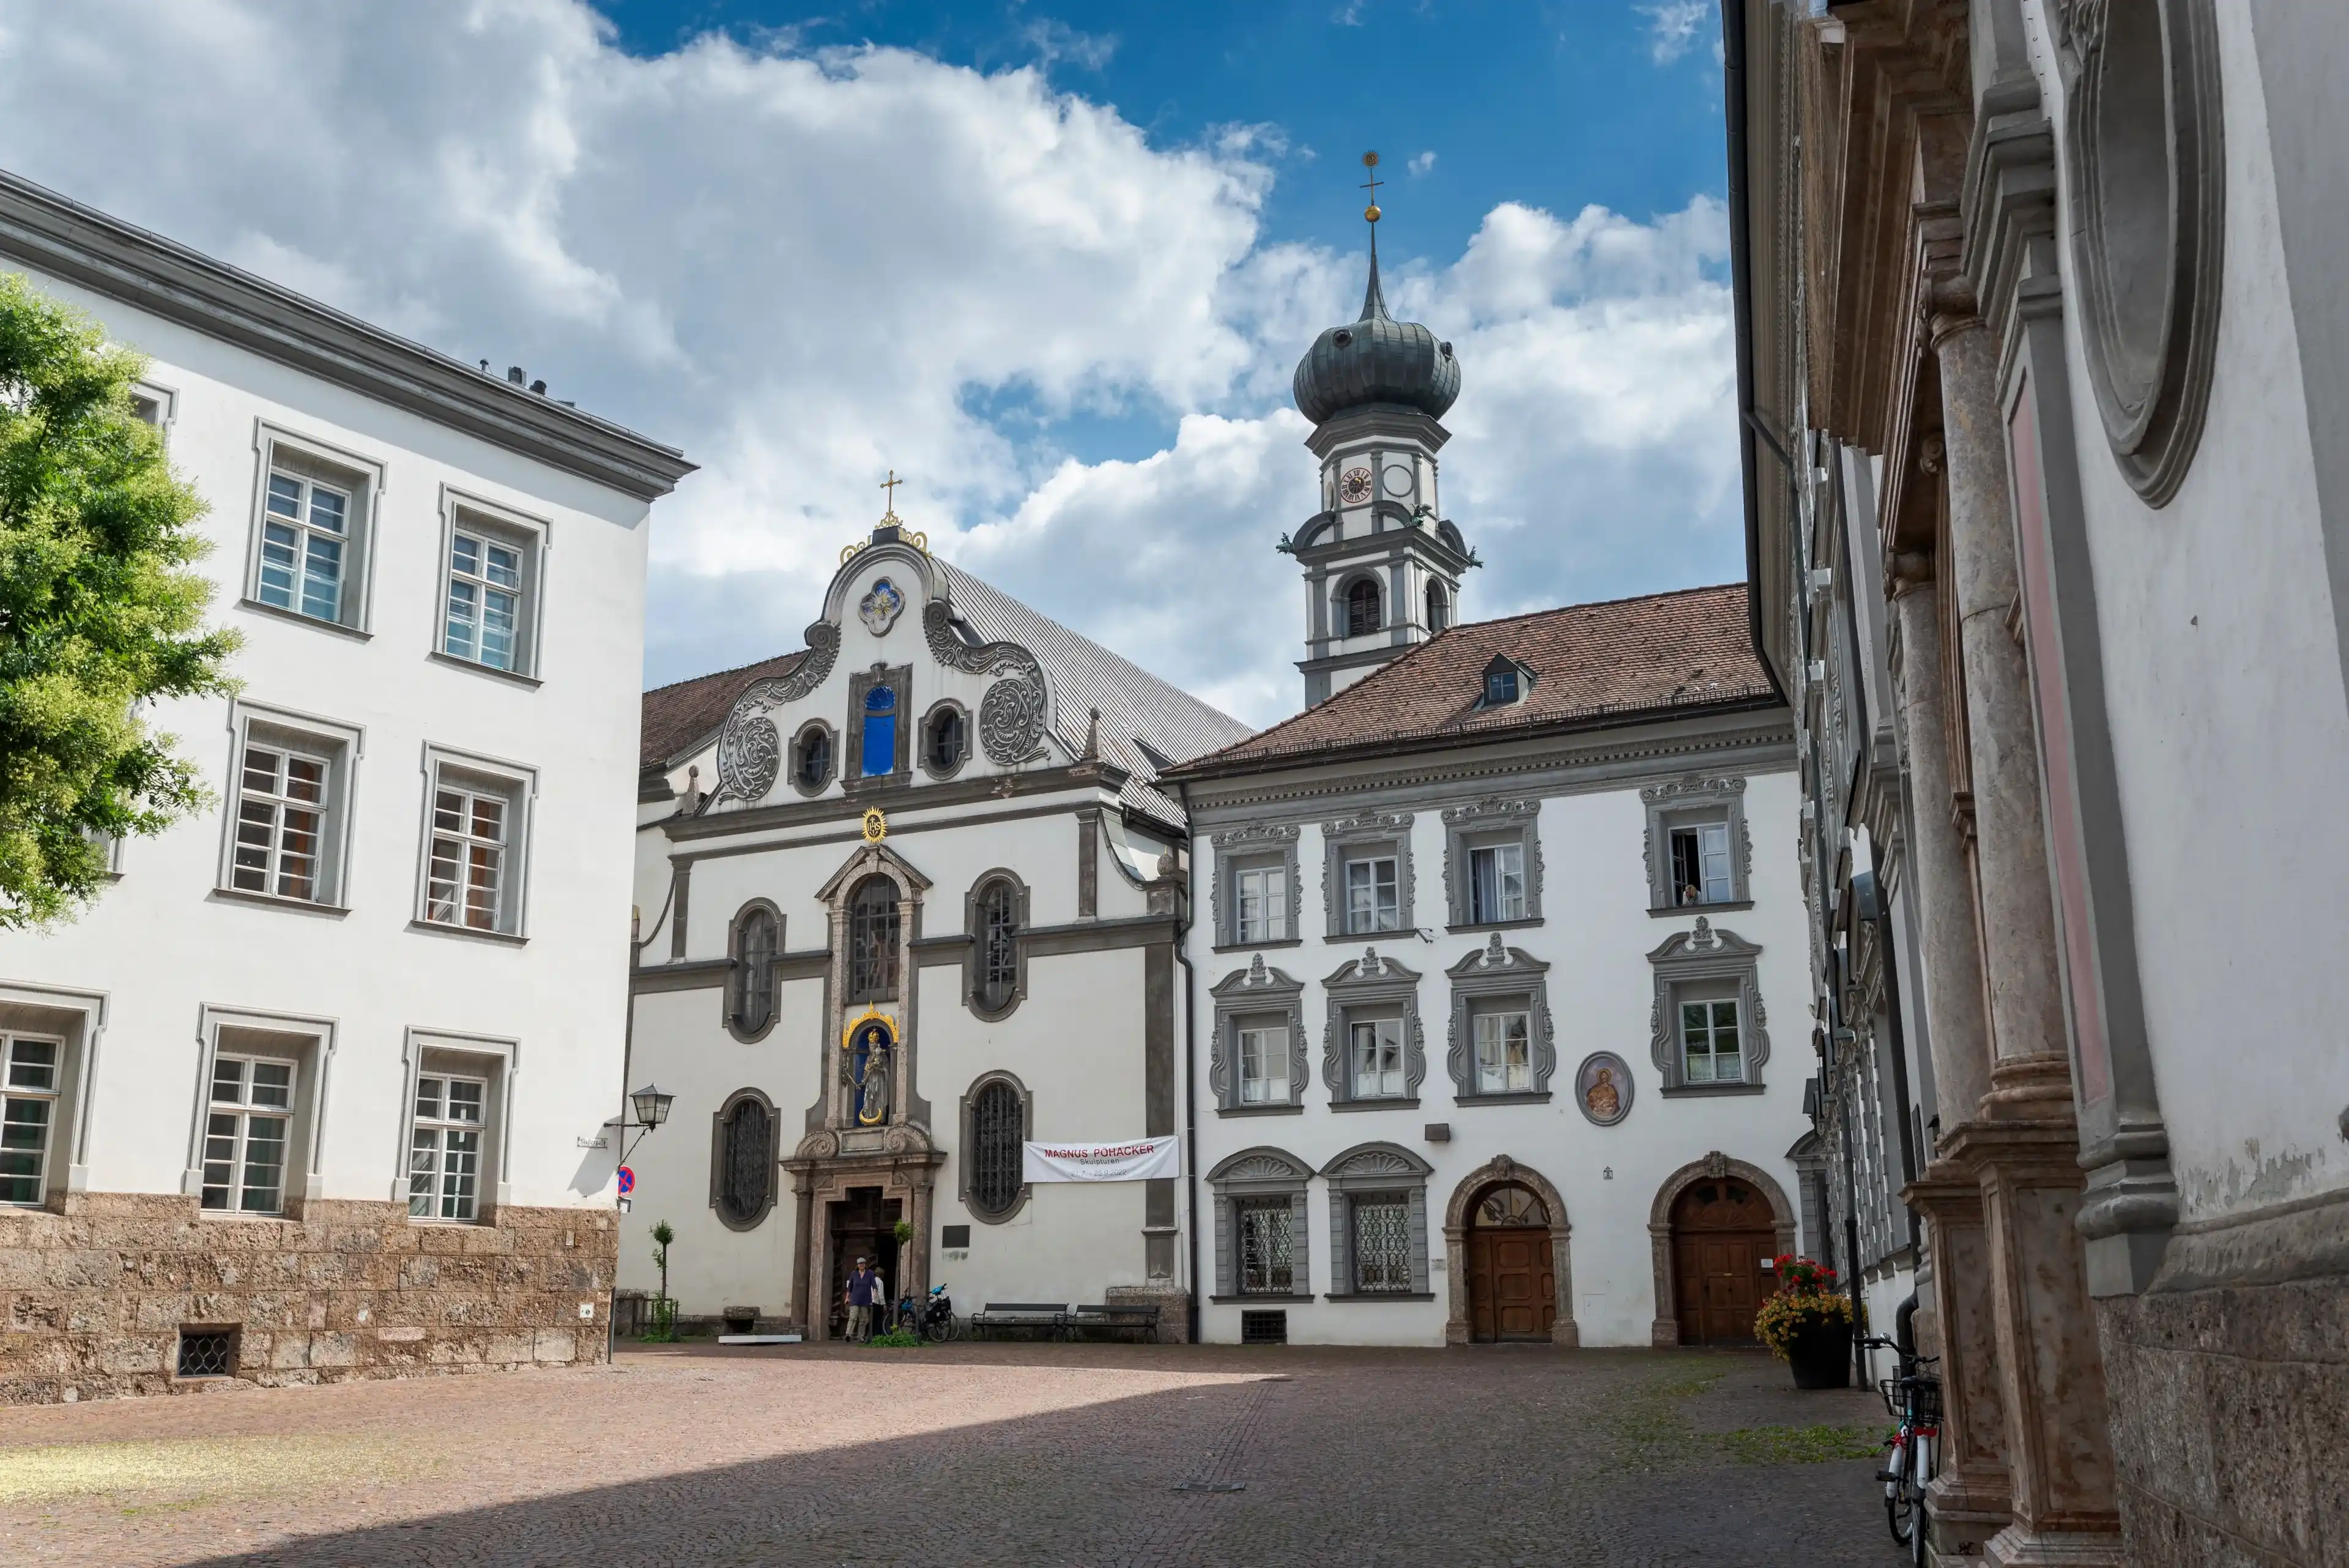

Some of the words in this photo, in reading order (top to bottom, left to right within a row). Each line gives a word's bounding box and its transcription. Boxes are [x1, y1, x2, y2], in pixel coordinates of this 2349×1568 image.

[867, 822, 880, 831] IHS
[1045, 1149, 1088, 1158] MAGNUS
[1094, 1145, 1154, 1157] PÖHACKER
